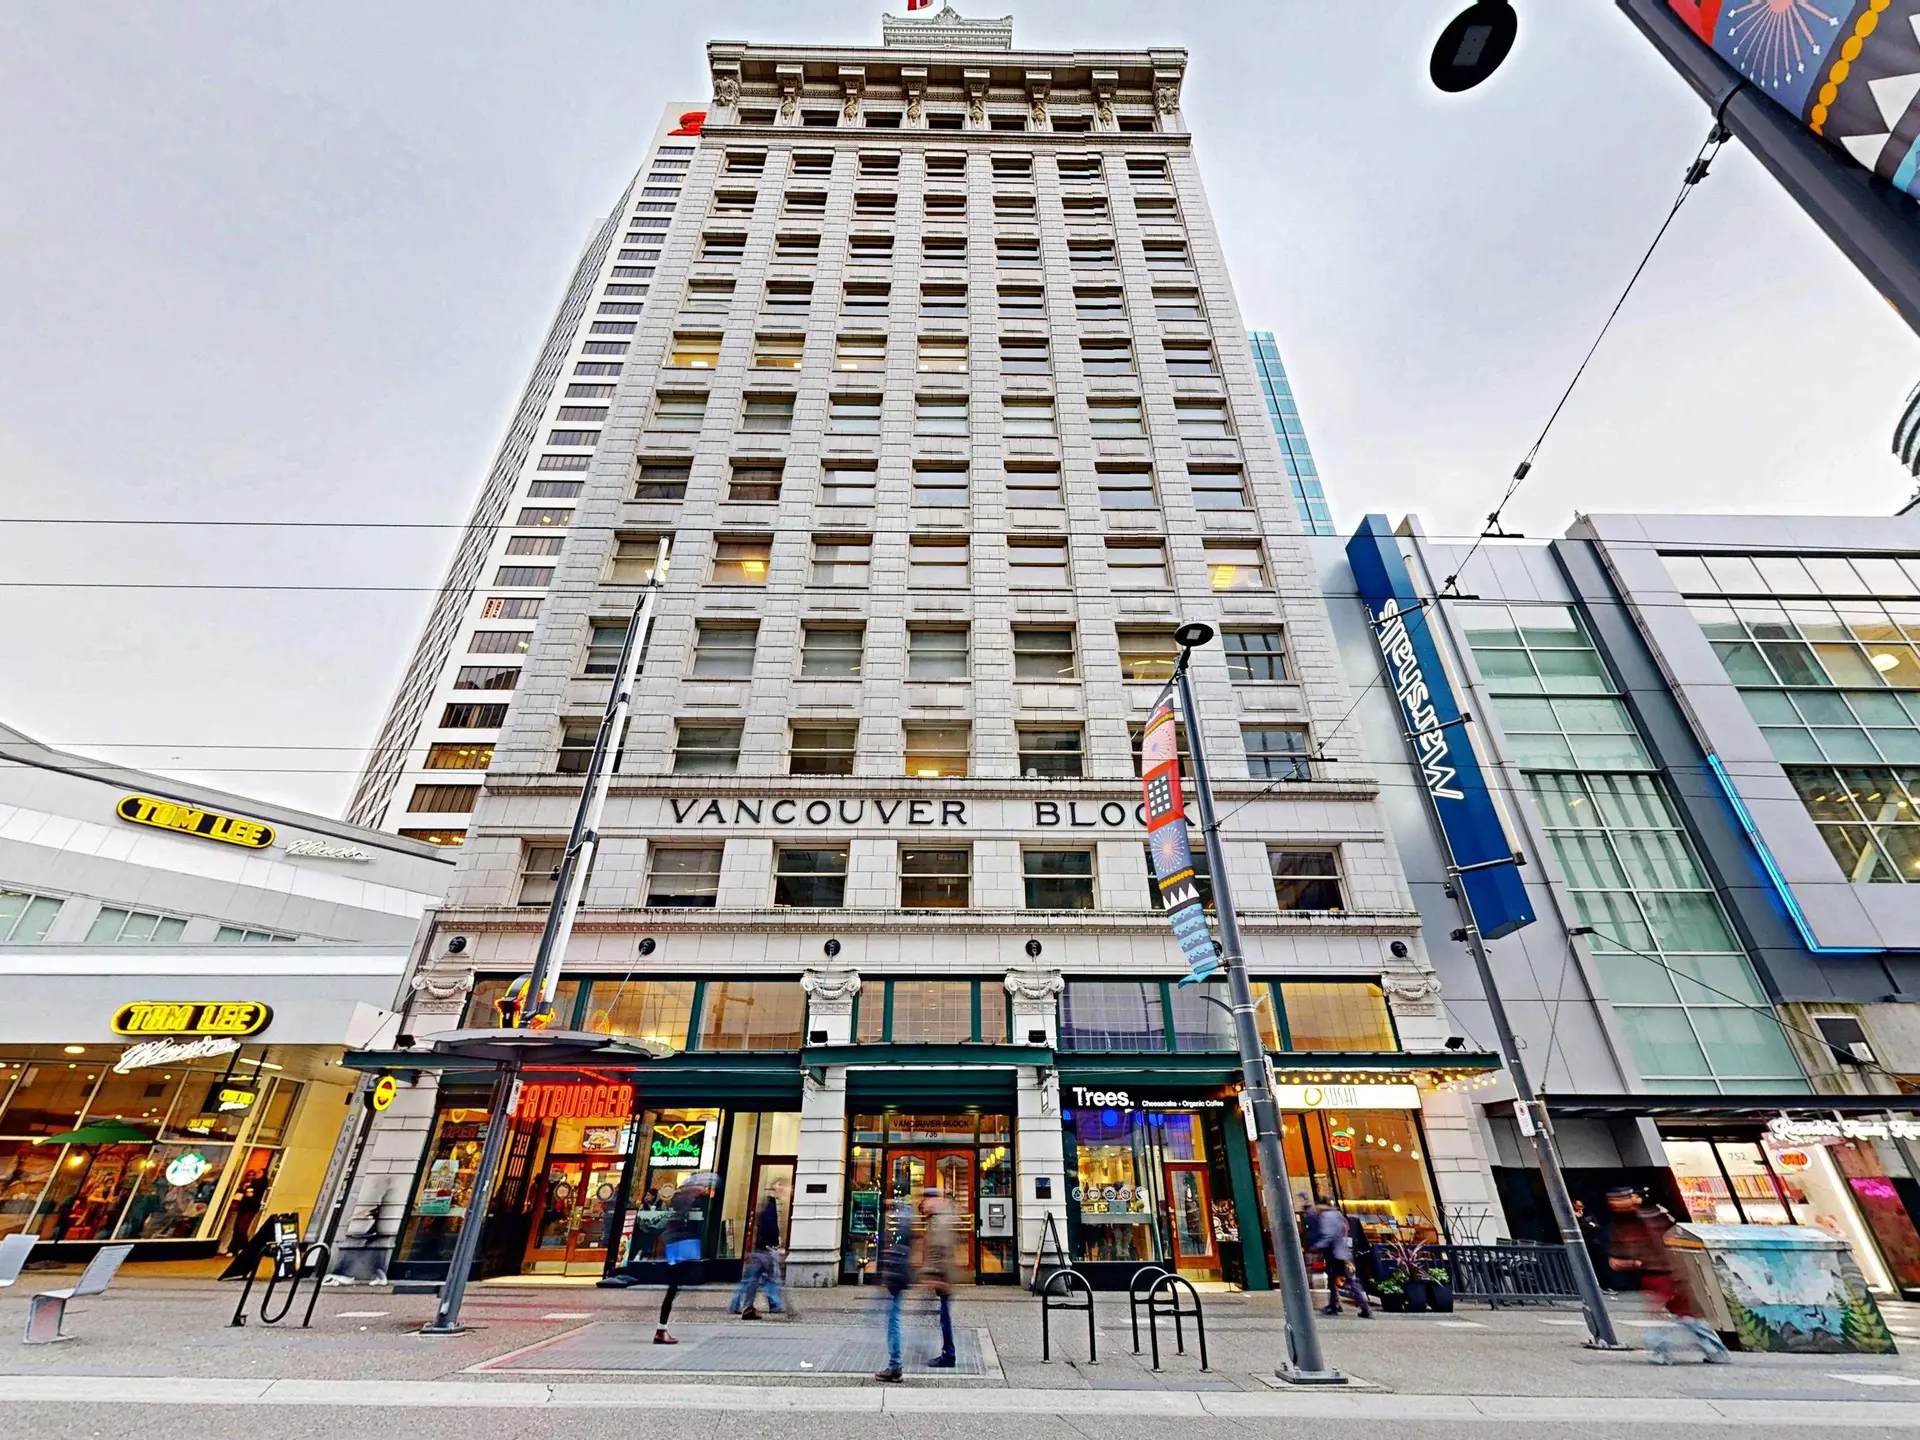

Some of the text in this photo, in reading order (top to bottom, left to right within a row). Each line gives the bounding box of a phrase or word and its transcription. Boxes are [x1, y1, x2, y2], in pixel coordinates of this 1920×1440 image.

[1379, 598, 1465, 800] Marshalls
[136, 798, 265, 845] TOM LEE
[670, 798, 968, 825] VANCOUVER
[284, 838, 377, 863] Music
[126, 1005, 255, 1031] TOM LEE
[113, 1035, 241, 1074] Music
[511, 1084, 633, 1118] FATBURGER
[1072, 1086, 1135, 1107] Trees.
[1141, 1099, 1177, 1107] Cheesecake
[1182, 1099, 1205, 1108] Organic
[1205, 1099, 1224, 1107] Coffee
[1323, 1087, 1358, 1106] SUSHI
[893, 1119, 969, 1128] VANCOUVER BLOCK
[651, 1139, 700, 1156] Buffalo's
[1331, 1136, 1352, 1147] OPEN
[1728, 1152, 1747, 1161] 752
